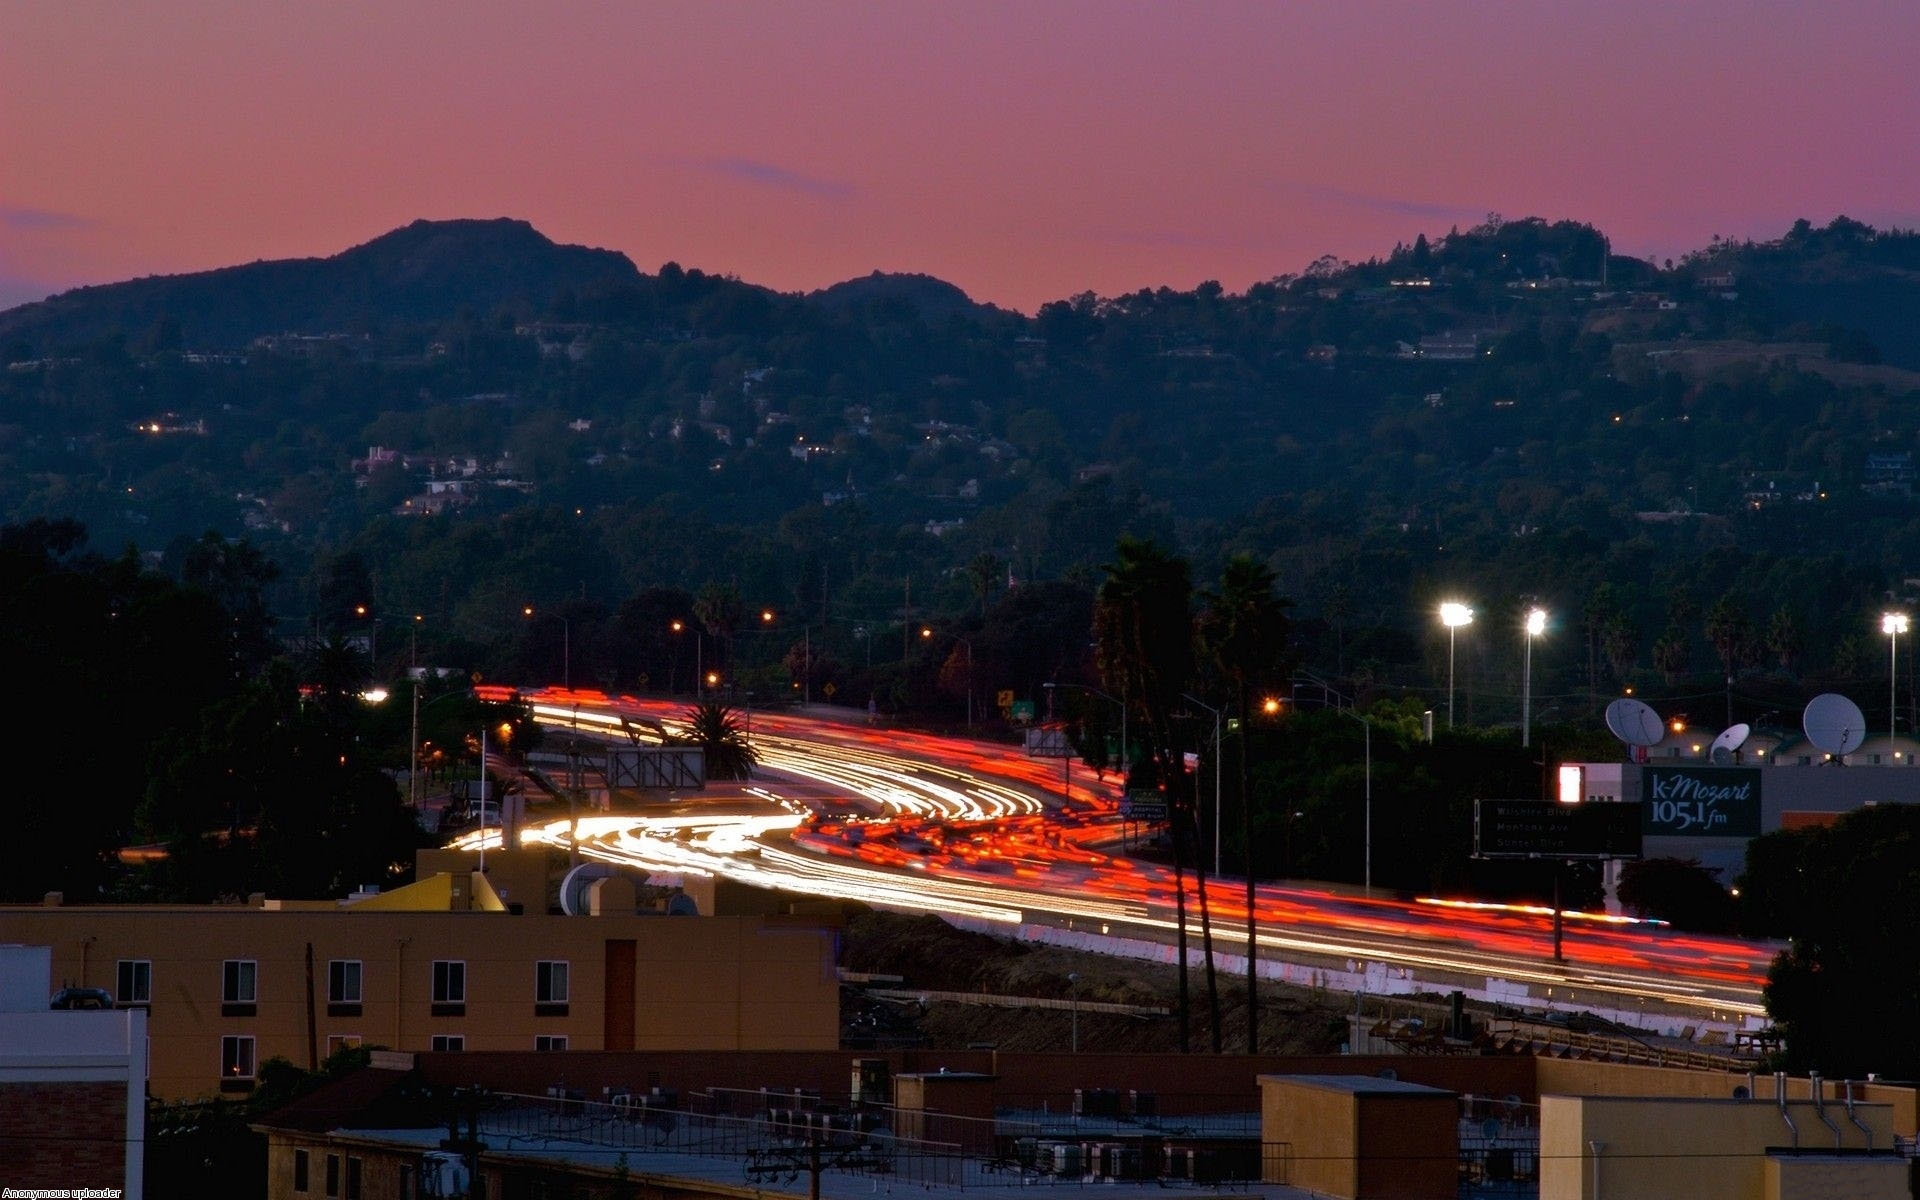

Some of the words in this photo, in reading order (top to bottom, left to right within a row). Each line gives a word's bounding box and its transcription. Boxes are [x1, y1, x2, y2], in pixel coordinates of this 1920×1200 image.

[1651, 773, 1752, 806] k-Mozart
[1650, 801, 1705, 830] 105.1
[1704, 809, 1728, 830] fm
